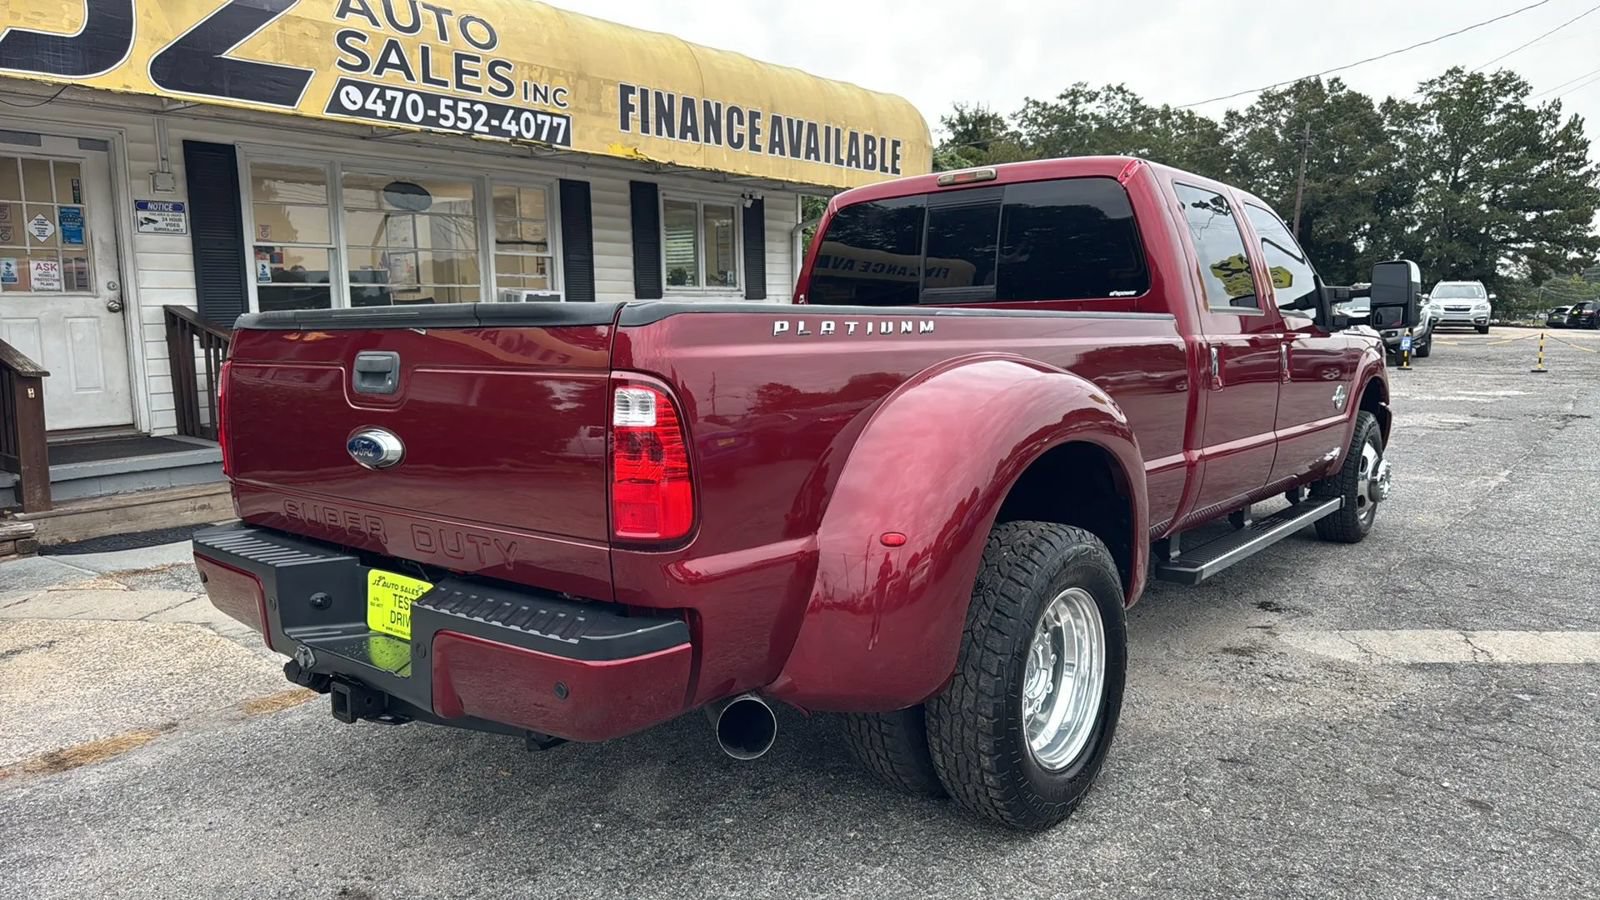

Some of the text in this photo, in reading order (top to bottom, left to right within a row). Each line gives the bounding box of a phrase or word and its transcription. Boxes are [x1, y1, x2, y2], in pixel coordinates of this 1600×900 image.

[335, 0, 499, 51] AUTO
[335, 29, 569, 107] SALES INC
[364, 88, 568, 143] 470-552-4077
[619, 83, 902, 175] FINANCE AVAILABLE
[147, 202, 174, 211] NOTICE
[35, 262, 58, 272] ASK
[773, 320, 935, 336] PLATIUNM
[283, 499, 518, 570] SUPER DUTY
[382, 581, 399, 591] AUTO
[400, 585, 420, 596] SALES
[390, 610, 411, 628] DRIV
